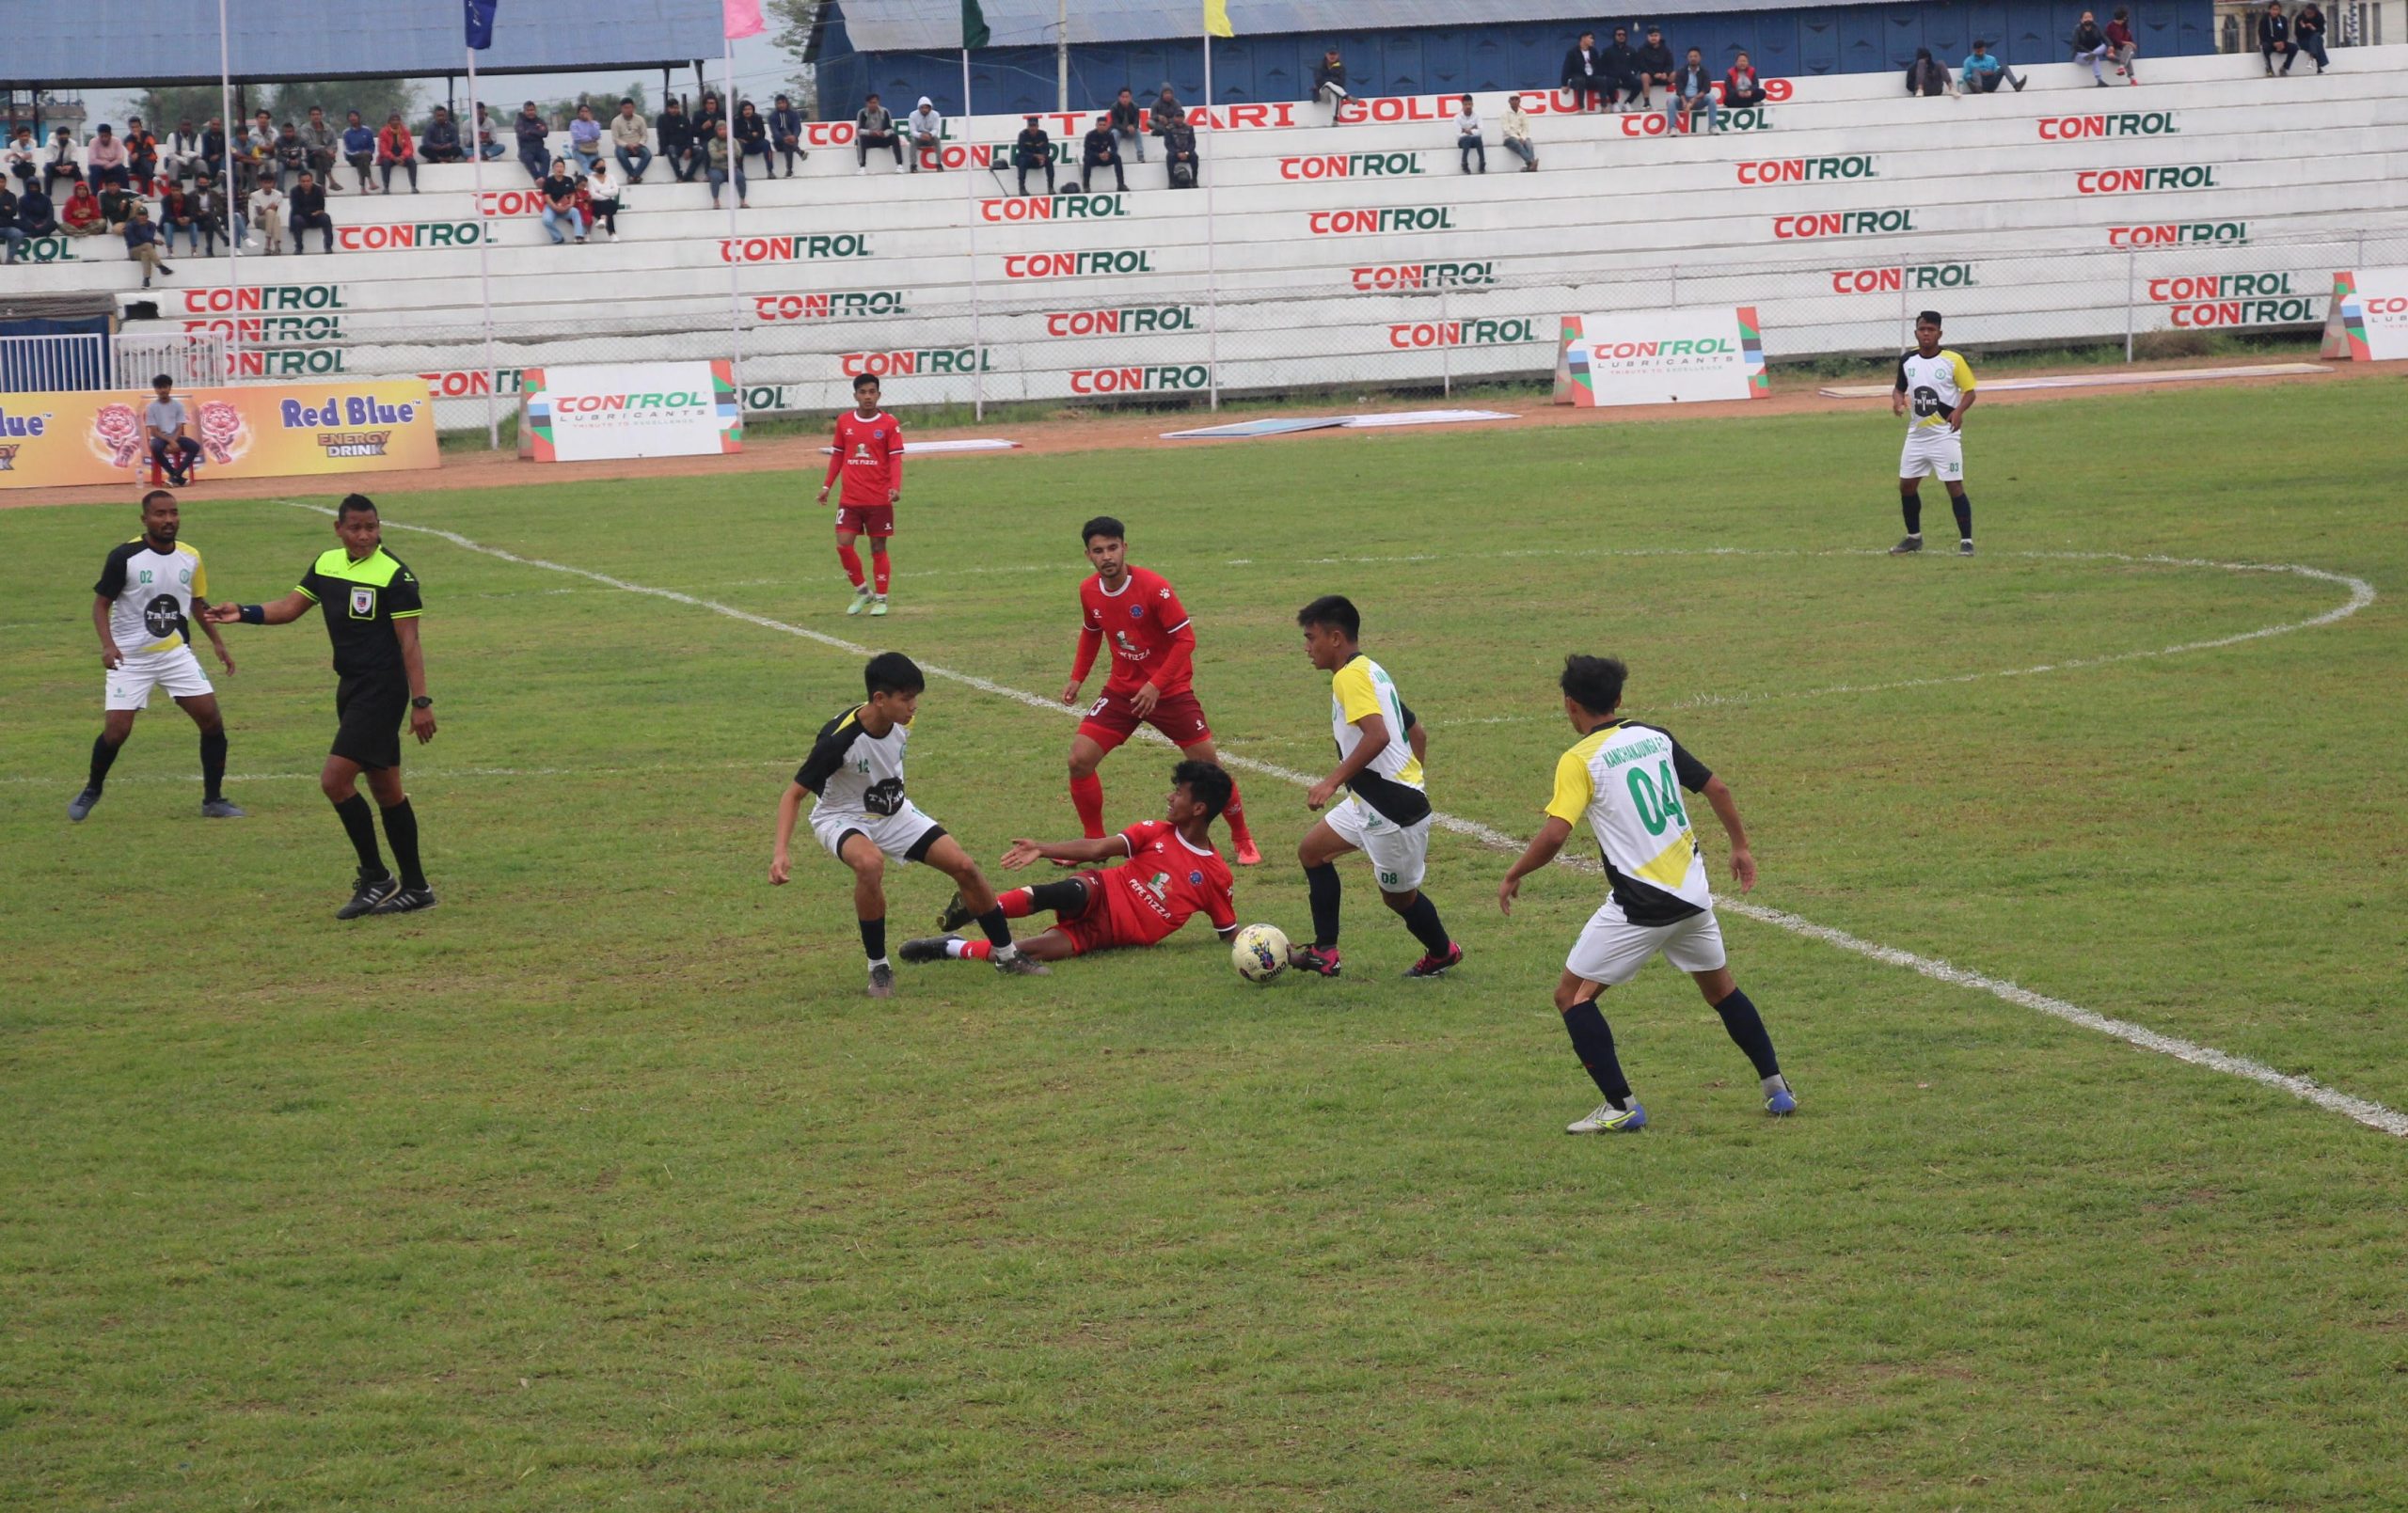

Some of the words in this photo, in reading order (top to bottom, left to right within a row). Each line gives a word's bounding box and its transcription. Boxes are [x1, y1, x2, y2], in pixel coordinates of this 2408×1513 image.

[1336, 95, 1466, 124] GOLD
[1620, 108, 1768, 136] CONTROL
[2036, 112, 2174, 140] CONTROL
[1279, 153, 1420, 180] CONTROL
[1735, 156, 1877, 184] CONTROL
[2076, 165, 2213, 194] CONTROL
[980, 195, 1126, 222] CONTROL
[1308, 207, 1450, 234] CONTROL
[336, 222, 492, 250] CONTROL
[1772, 210, 1913, 239] CONTROL
[2108, 222, 2247, 250] CONTROL
[721, 234, 868, 262] CONTROL
[1004, 251, 1149, 278] CONTROL
[1351, 262, 1494, 291] CONTROL
[1831, 265, 1973, 294] CONTROL
[2147, 273, 2290, 302] CONTROL
[182, 285, 342, 313] CONTROL
[752, 292, 906, 321] CONTROL
[2170, 298, 2313, 327] CONTROL
[1046, 307, 1194, 337] CONTROL
[1389, 320, 1535, 348] CONTROL
[840, 349, 989, 377] CONTROL
[1591, 338, 1735, 360] CONTROL
[1597, 356, 1734, 369] LUBRICANTS
[280, 398, 341, 428] Red
[345, 396, 414, 425] Blue
[553, 391, 707, 413] CONTROL
[560, 409, 705, 422] LUBRICANTS
[0, 407, 43, 437] lue
[318, 431, 391, 447] ENERGY
[327, 444, 387, 457] DRINK
[1950, 462, 1959, 473] 03
[139, 570, 153, 584] 02
[1626, 760, 1687, 836] 04
[1381, 872, 1399, 885] 08
[1129, 878, 1148, 897] PEPE
[1144, 894, 1172, 920] PIZZA
